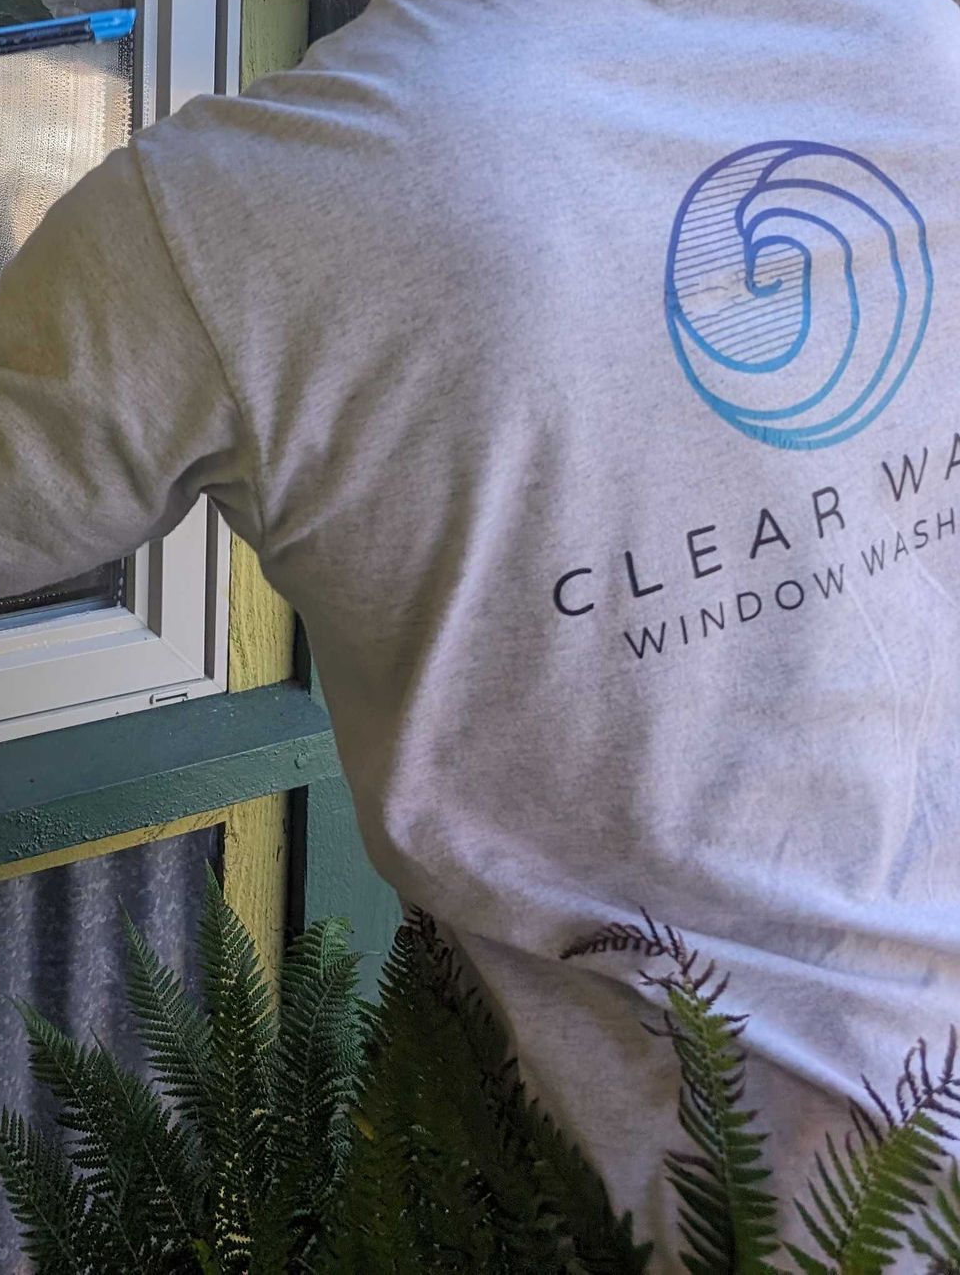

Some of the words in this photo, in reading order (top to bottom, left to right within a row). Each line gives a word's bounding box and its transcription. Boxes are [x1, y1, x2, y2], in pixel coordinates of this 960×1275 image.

[553, 486, 845, 616] CLEAR
[624, 563, 845, 659] WINDOW
[860, 508, 956, 576] WASH
